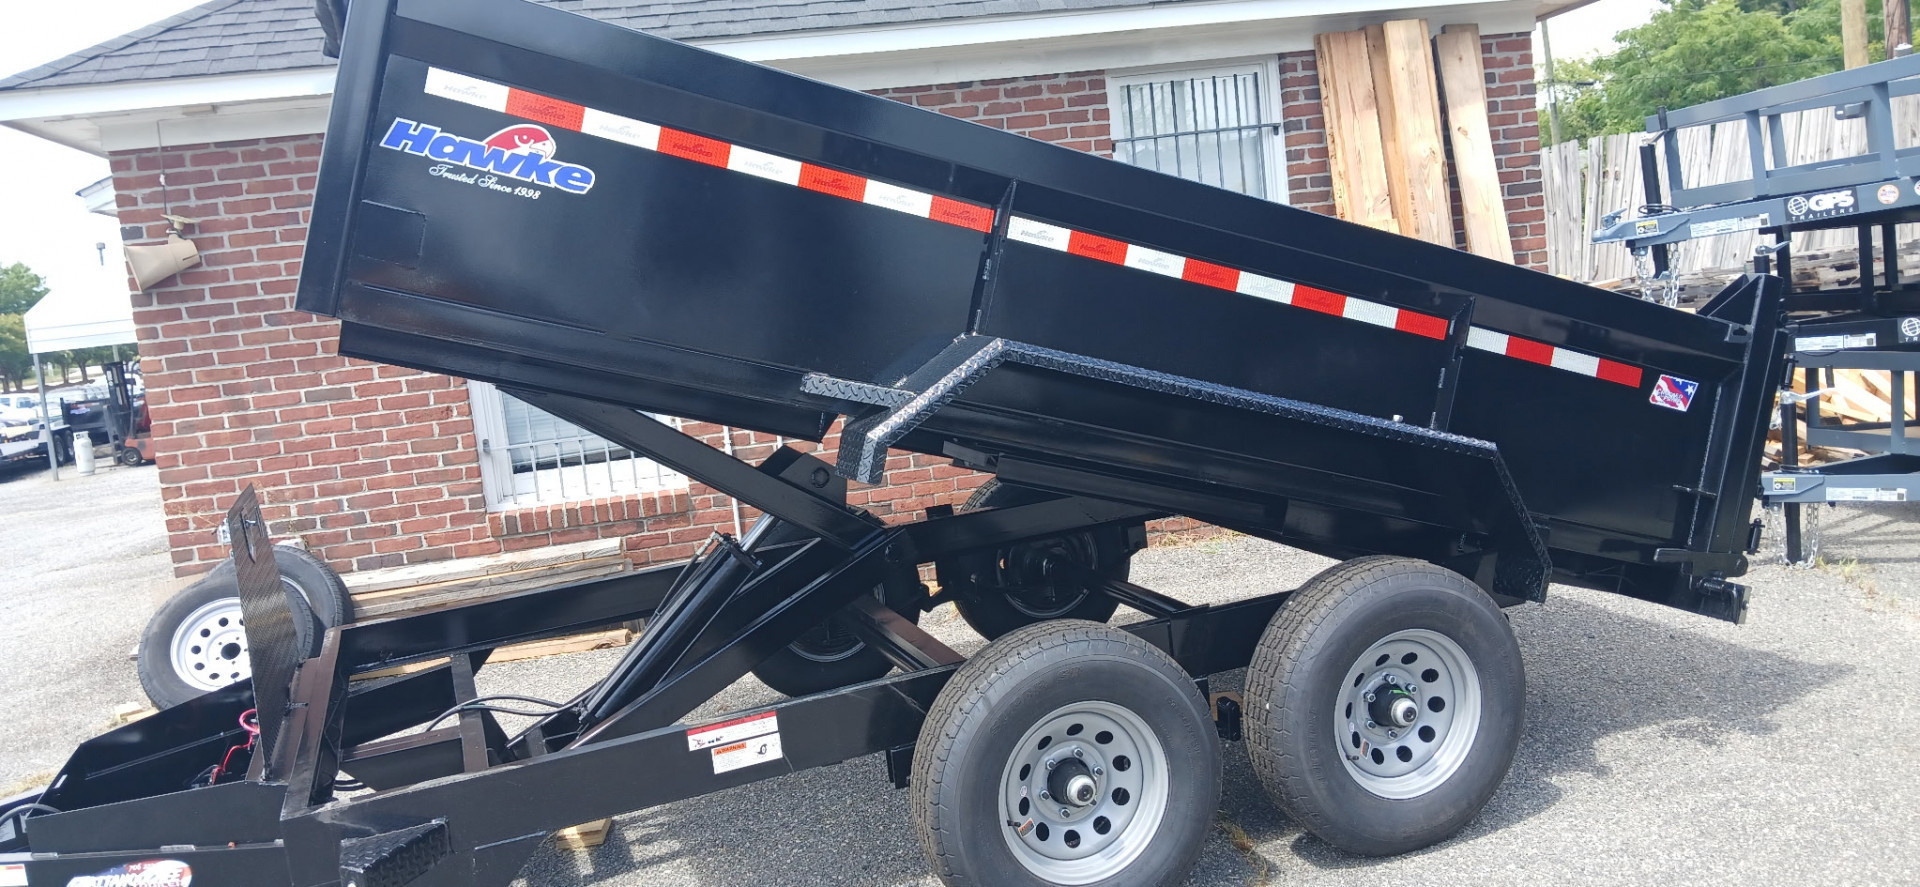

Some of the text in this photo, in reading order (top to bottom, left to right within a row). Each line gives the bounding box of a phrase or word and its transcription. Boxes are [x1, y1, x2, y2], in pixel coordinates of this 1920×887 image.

[380, 118, 595, 194] Hawke
[429, 164, 541, 200] Trusted Since 1998
[1792, 207, 1854, 222] TRAILERS
[1809, 190, 1855, 211] GPS
